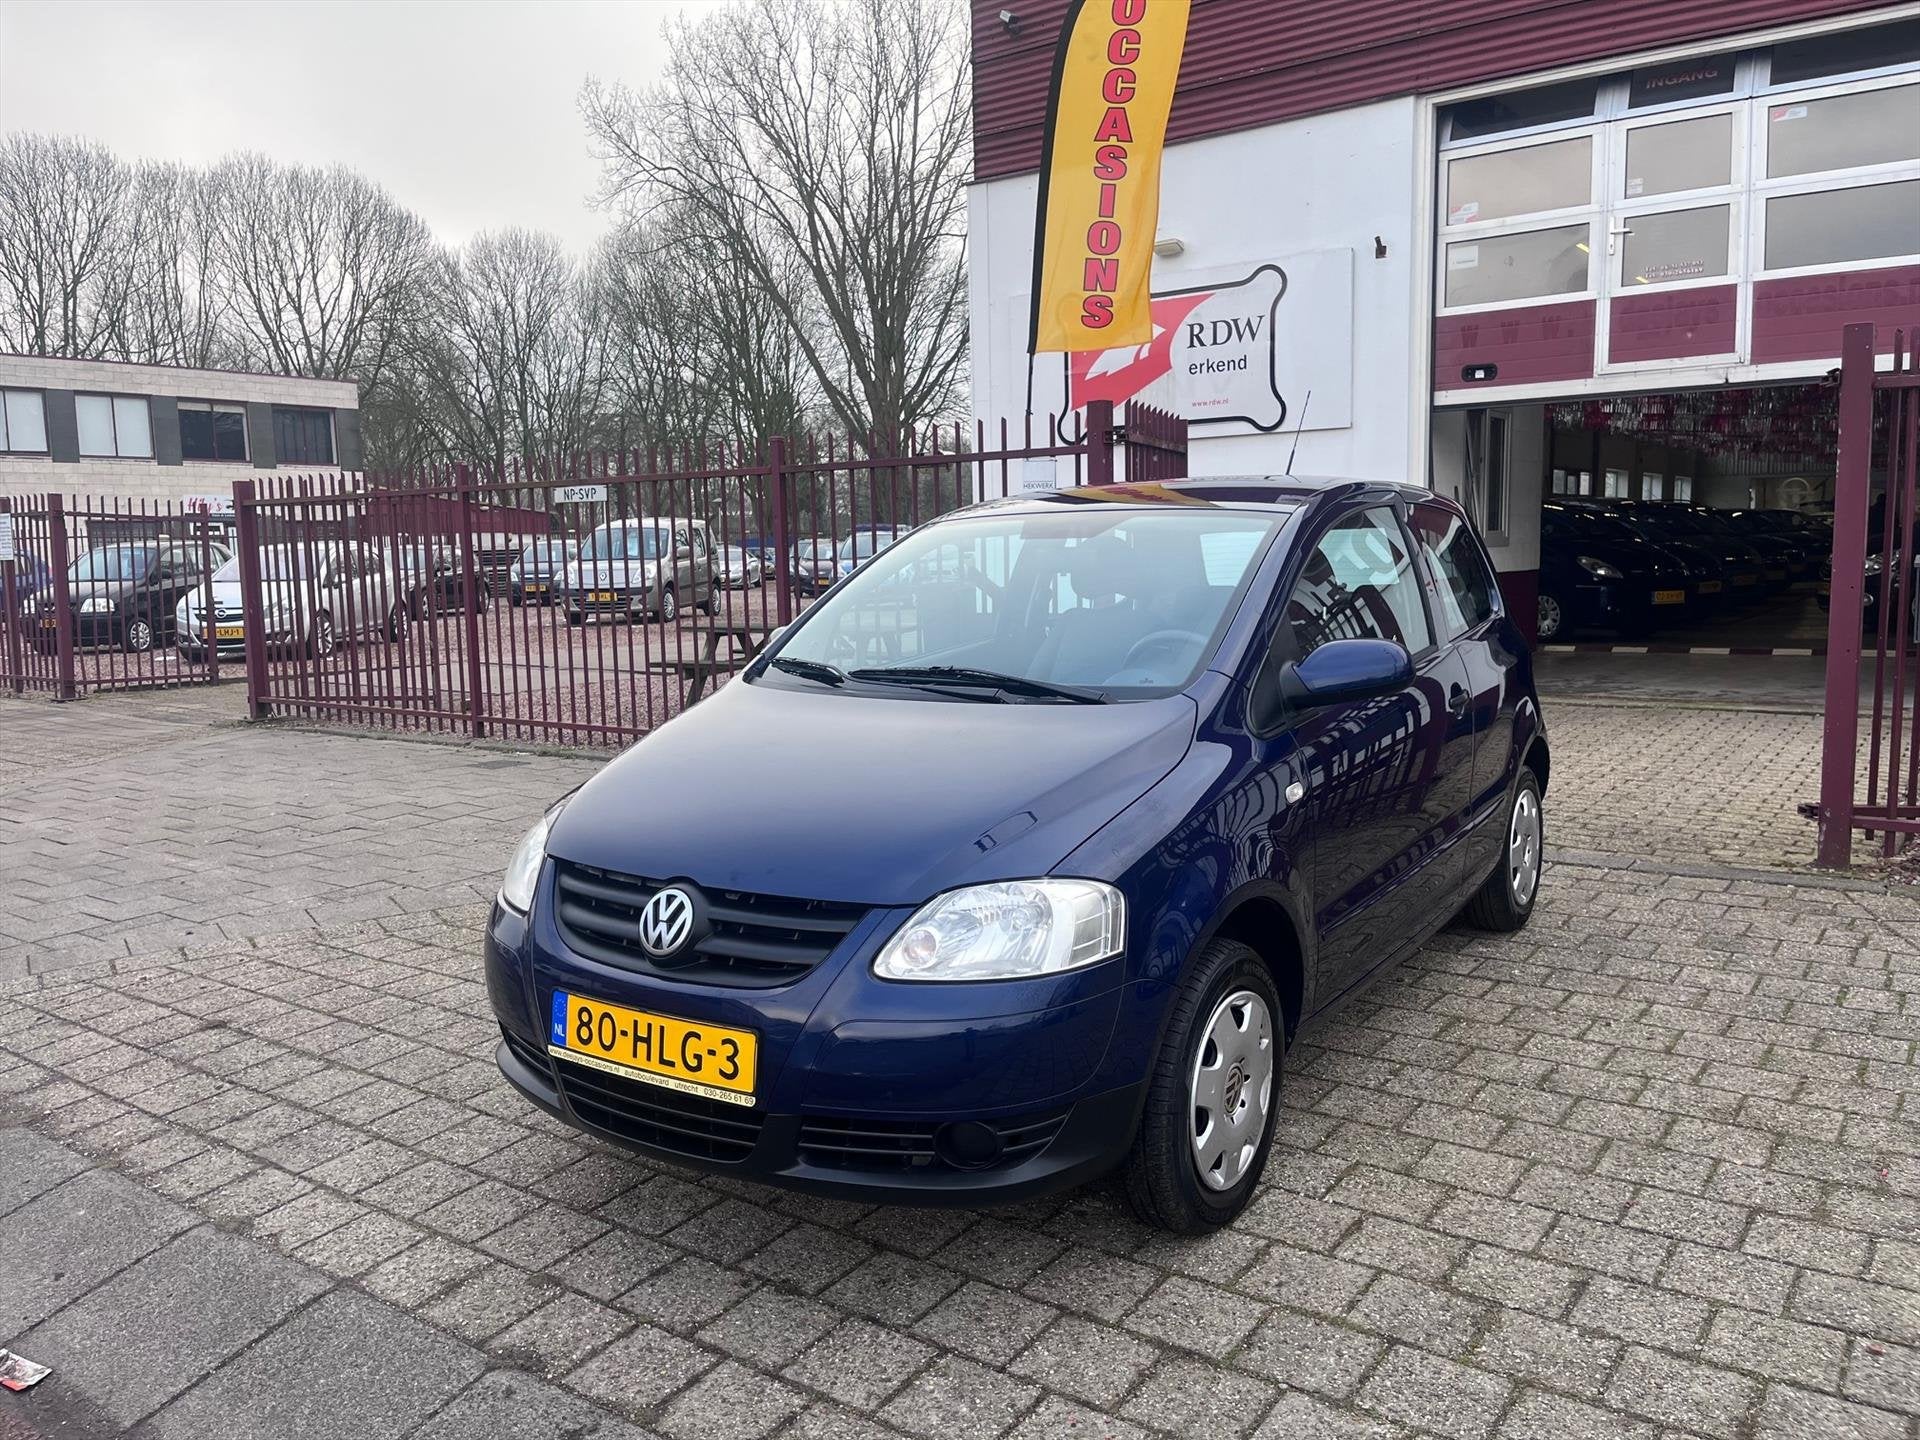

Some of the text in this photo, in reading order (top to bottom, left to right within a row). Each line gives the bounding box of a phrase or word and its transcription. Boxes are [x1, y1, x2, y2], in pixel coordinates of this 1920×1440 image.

[1081, 0, 1146, 329] OCCASIONS
[1186, 314, 1265, 349] RDW
[1188, 354, 1247, 375] erkend
[1192, 398, 1229, 407] www.rdw.nl
[563, 487, 596, 500] NP-SVP
[554, 1022, 565, 1037] NL
[576, 1006, 739, 1080] 80-HLG-3
[624, 1070, 670, 1087] autoboulevard
[674, 1082, 699, 1093] utrecht
[744, 1096, 754, 1105] 69
